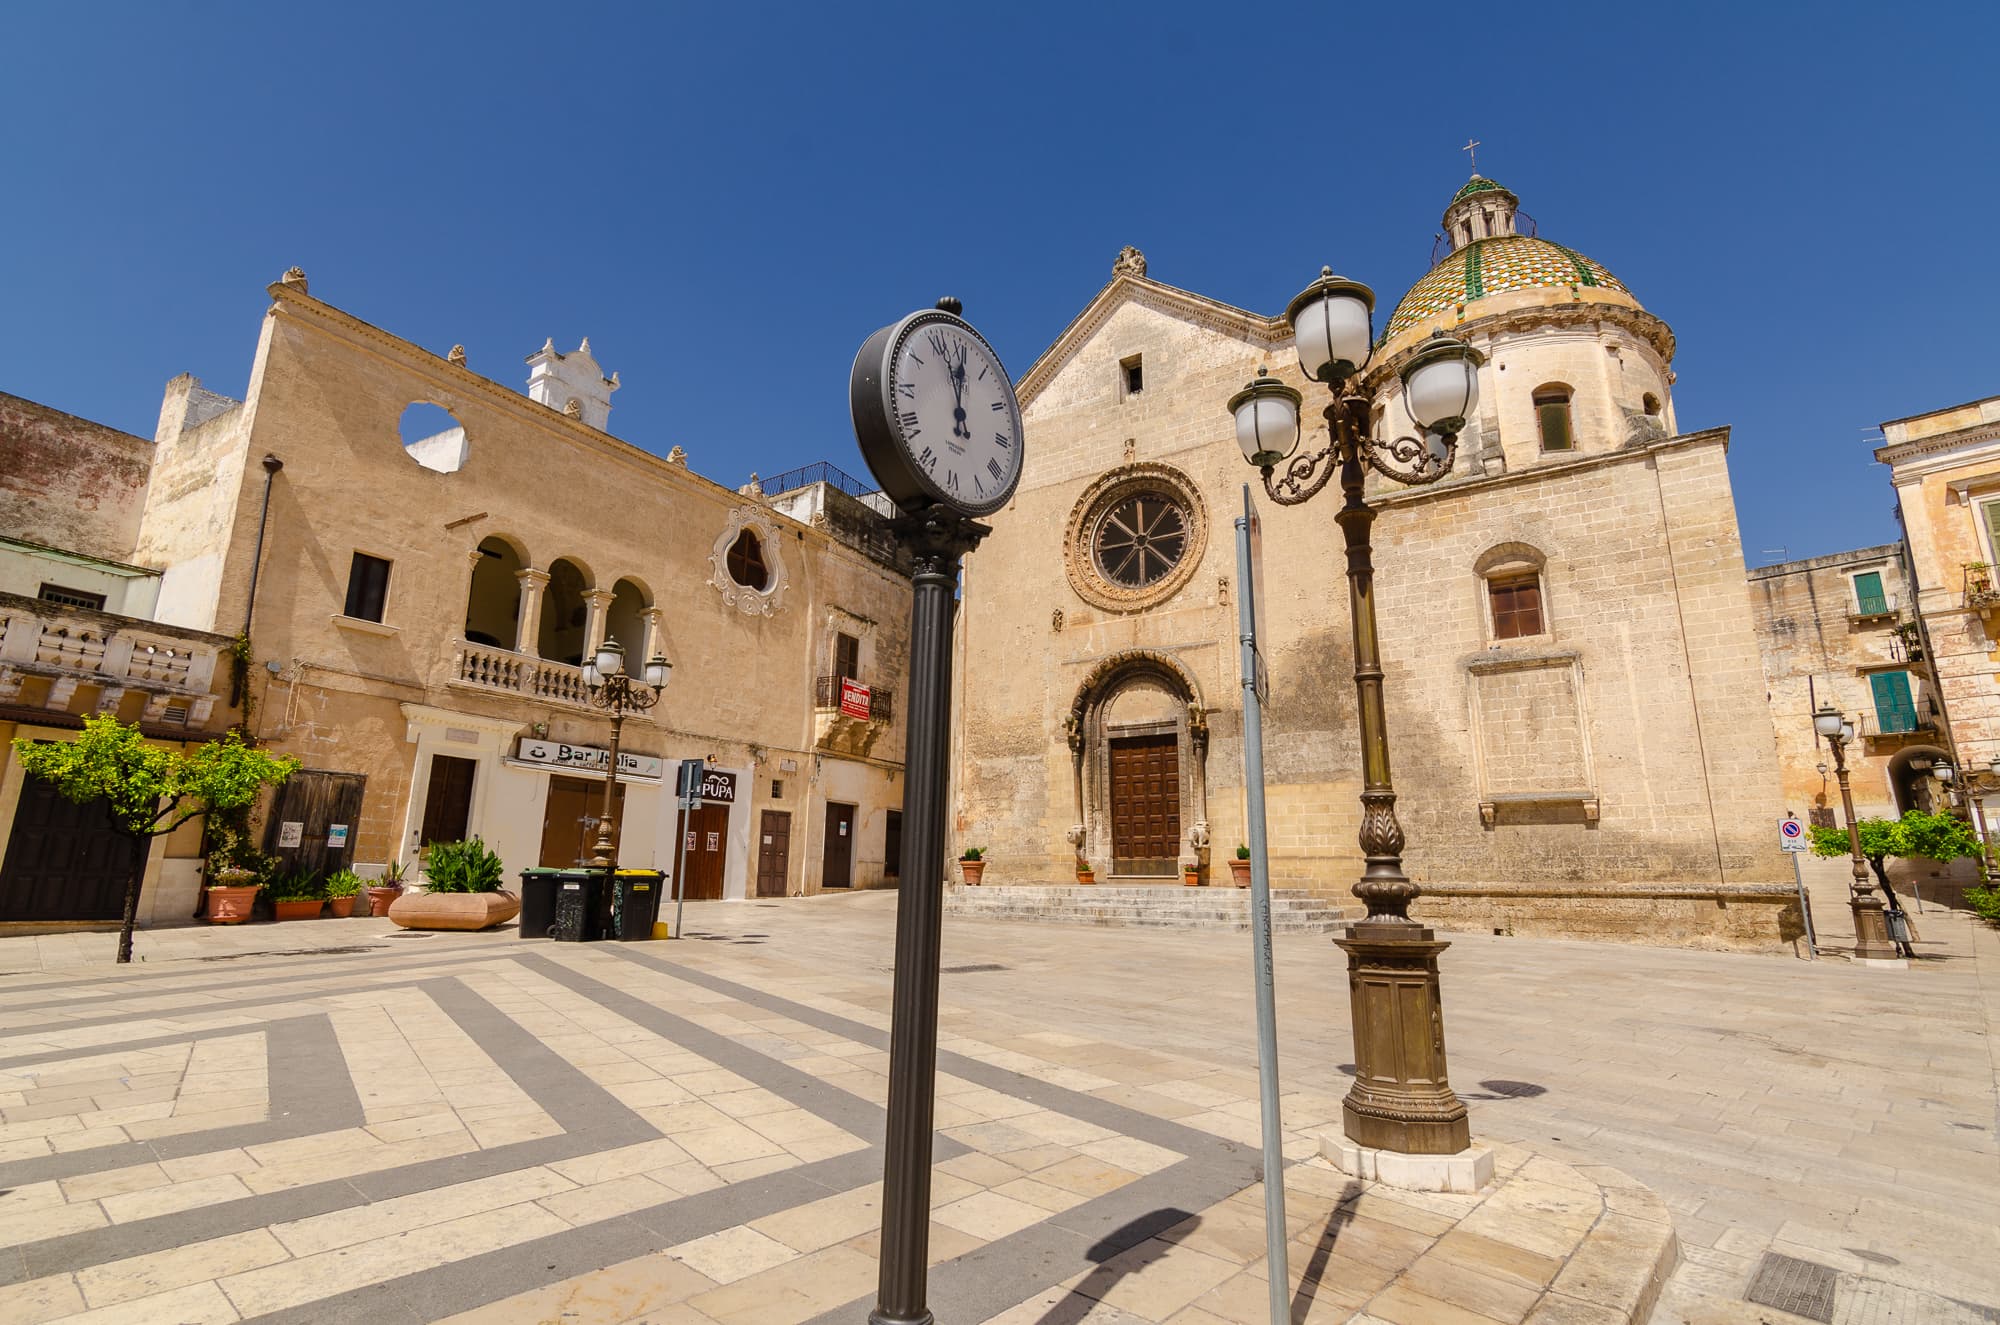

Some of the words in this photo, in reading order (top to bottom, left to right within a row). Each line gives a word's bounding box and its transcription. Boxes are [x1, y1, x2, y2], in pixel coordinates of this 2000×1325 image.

[991, 402, 1004, 411] II
[901, 411, 921, 440] VIII
[995, 432, 1008, 449] III
[919, 446, 937, 475] VII
[947, 469, 958, 491] VI
[974, 474, 984, 495] V
[558, 744, 592, 761] Bar
[702, 775, 734, 799] PUPA
